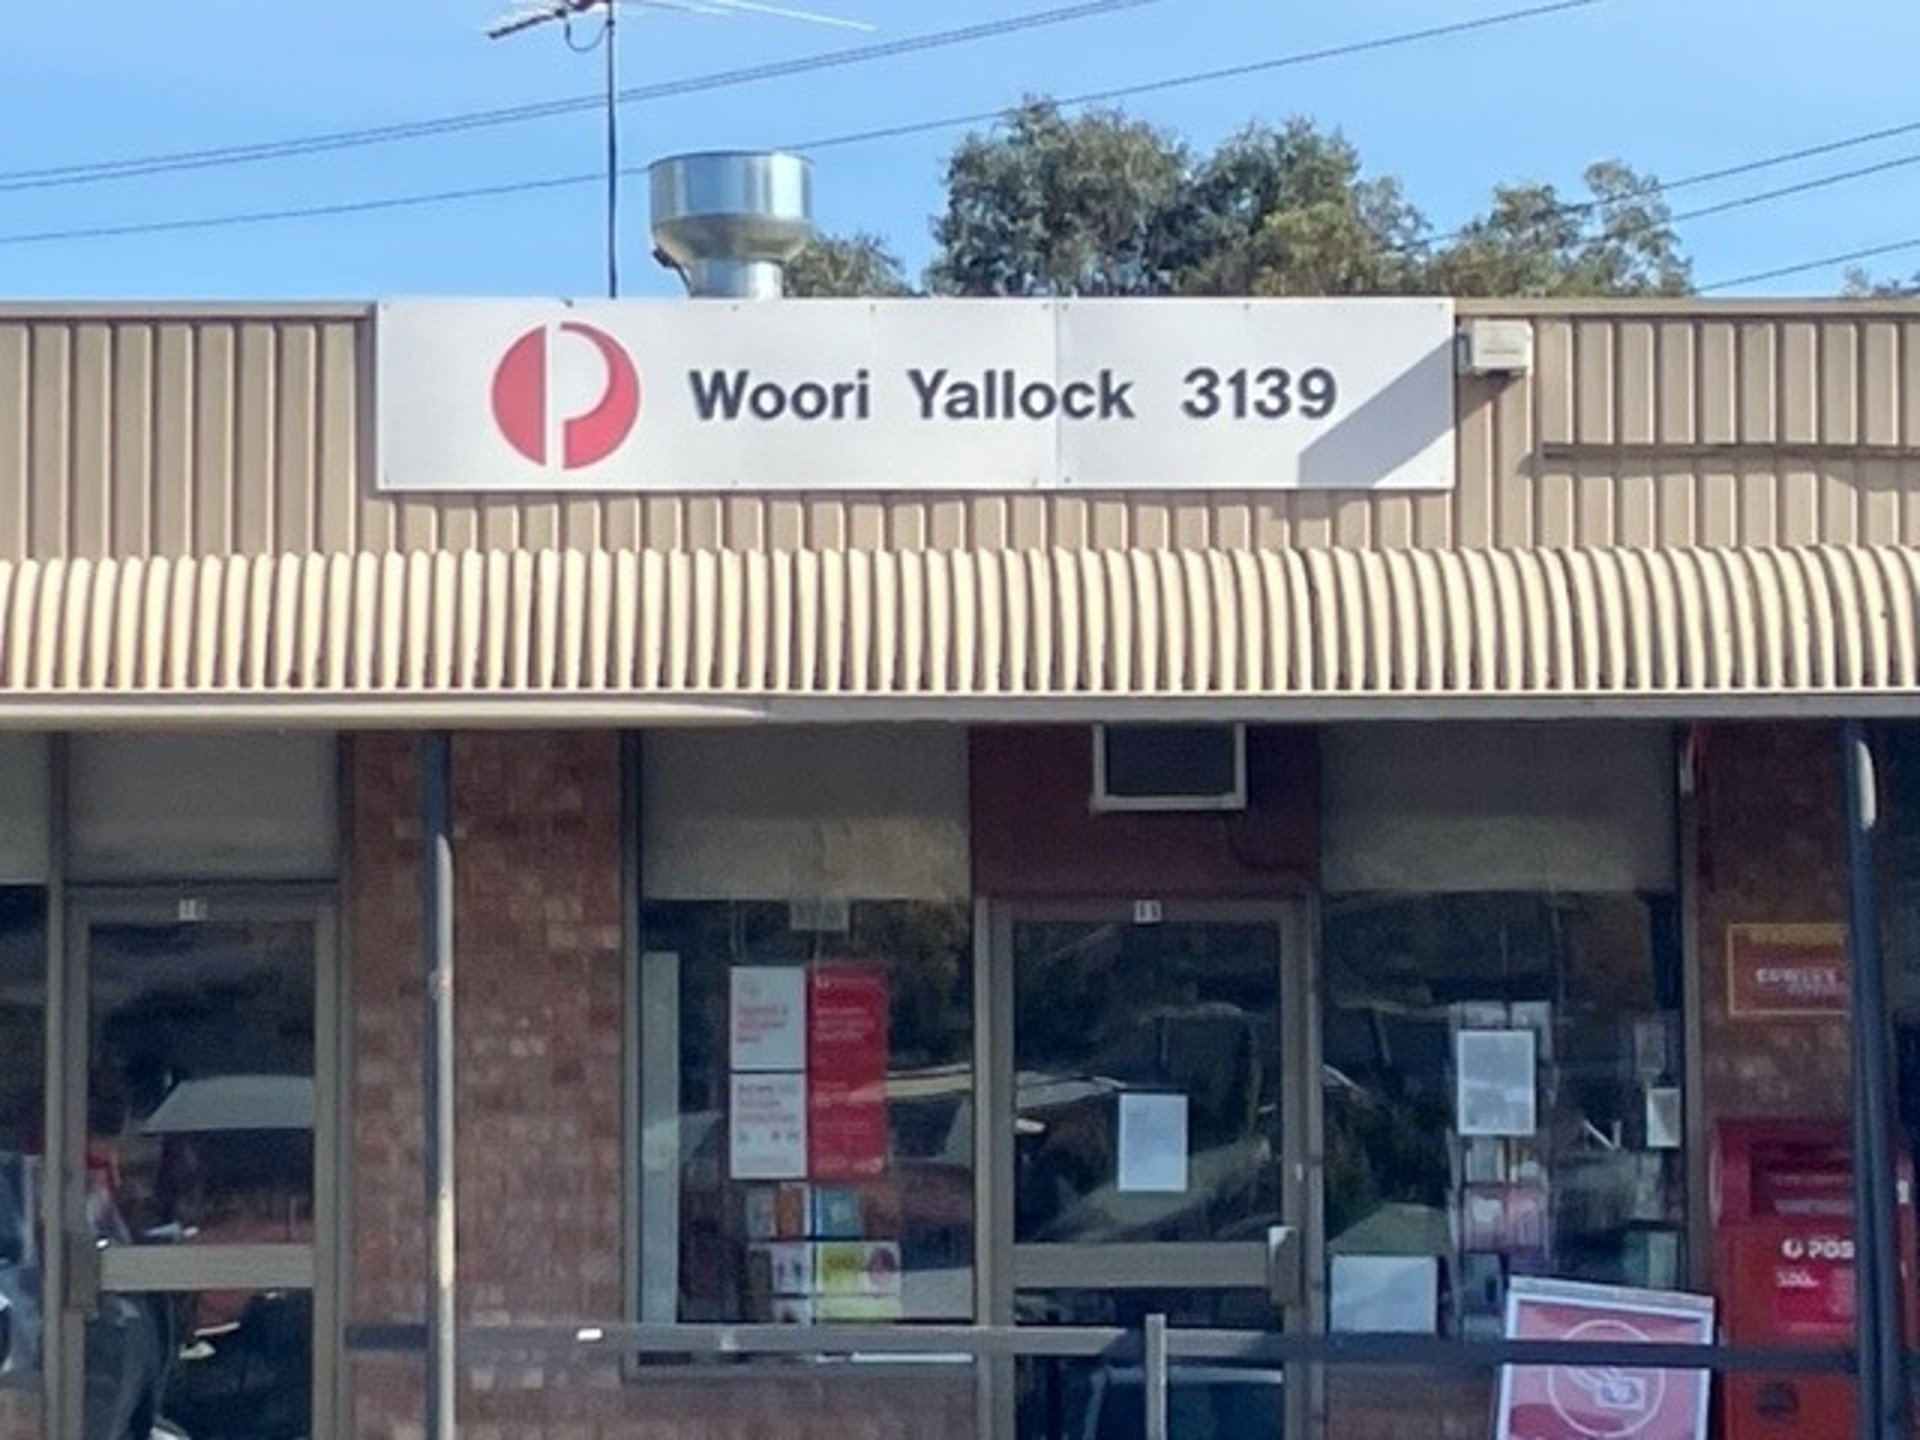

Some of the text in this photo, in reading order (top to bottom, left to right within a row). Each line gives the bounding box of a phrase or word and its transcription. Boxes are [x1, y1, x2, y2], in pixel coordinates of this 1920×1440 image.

[689, 366, 1337, 420] Woori Yallock 3139
